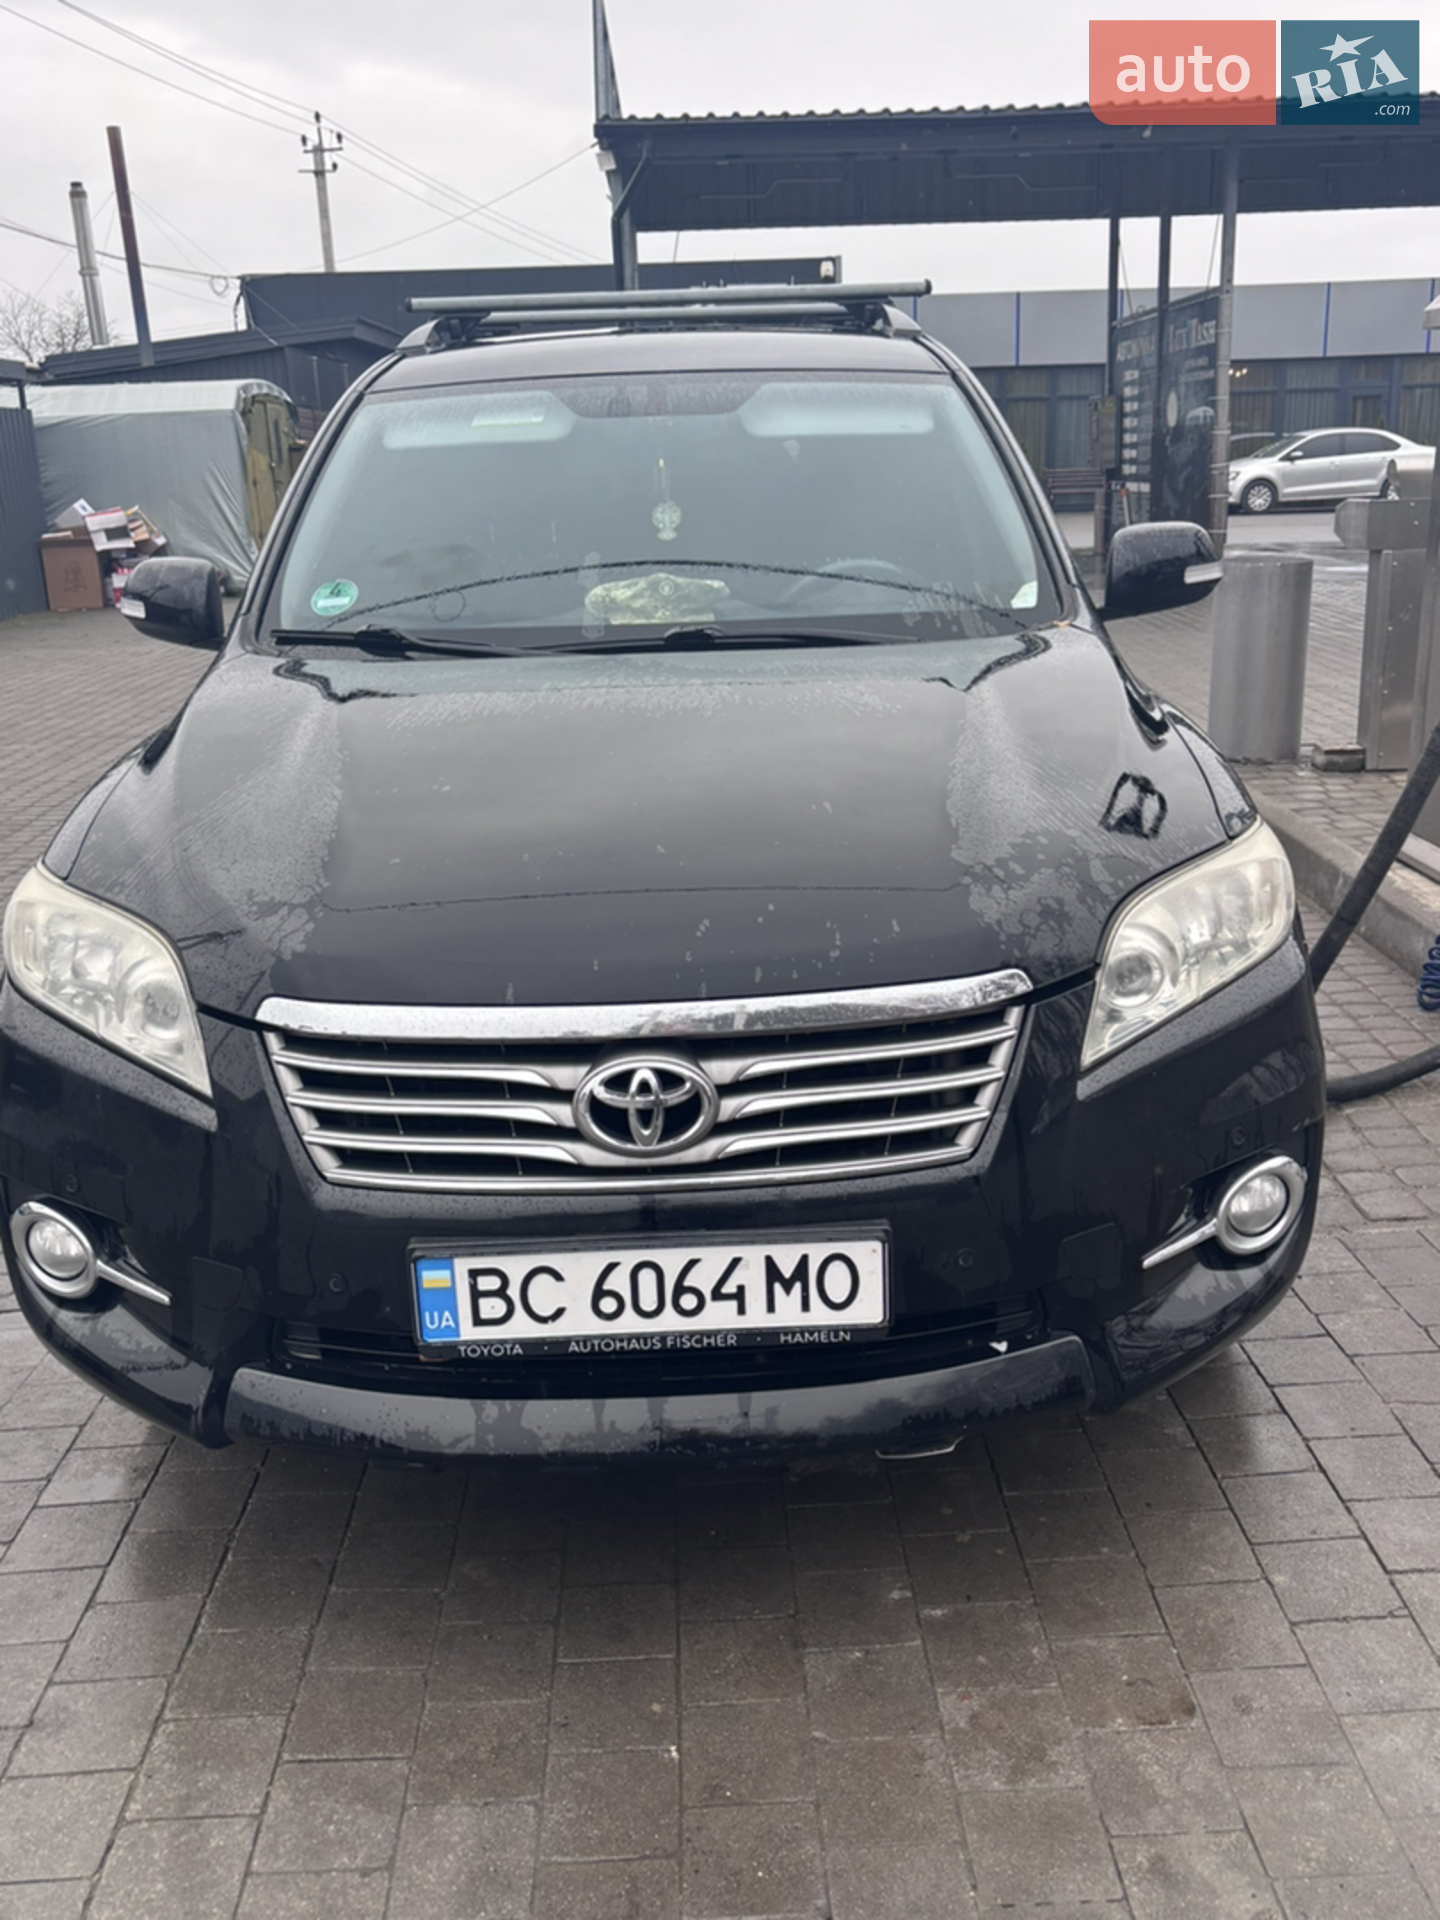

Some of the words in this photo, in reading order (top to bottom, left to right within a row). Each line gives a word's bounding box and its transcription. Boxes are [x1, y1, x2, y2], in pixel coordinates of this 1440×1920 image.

[467, 1265, 566, 1327] BC
[590, 1257, 746, 1320] 6064
[764, 1252, 860, 1314] MO
[425, 1310, 455, 1329] UA
[458, 1344, 523, 1357] TOYOTA
[568, 1336, 661, 1353] AUTOHAUS
[666, 1334, 737, 1349] FISCHER
[780, 1330, 851, 1345] HAMELN
